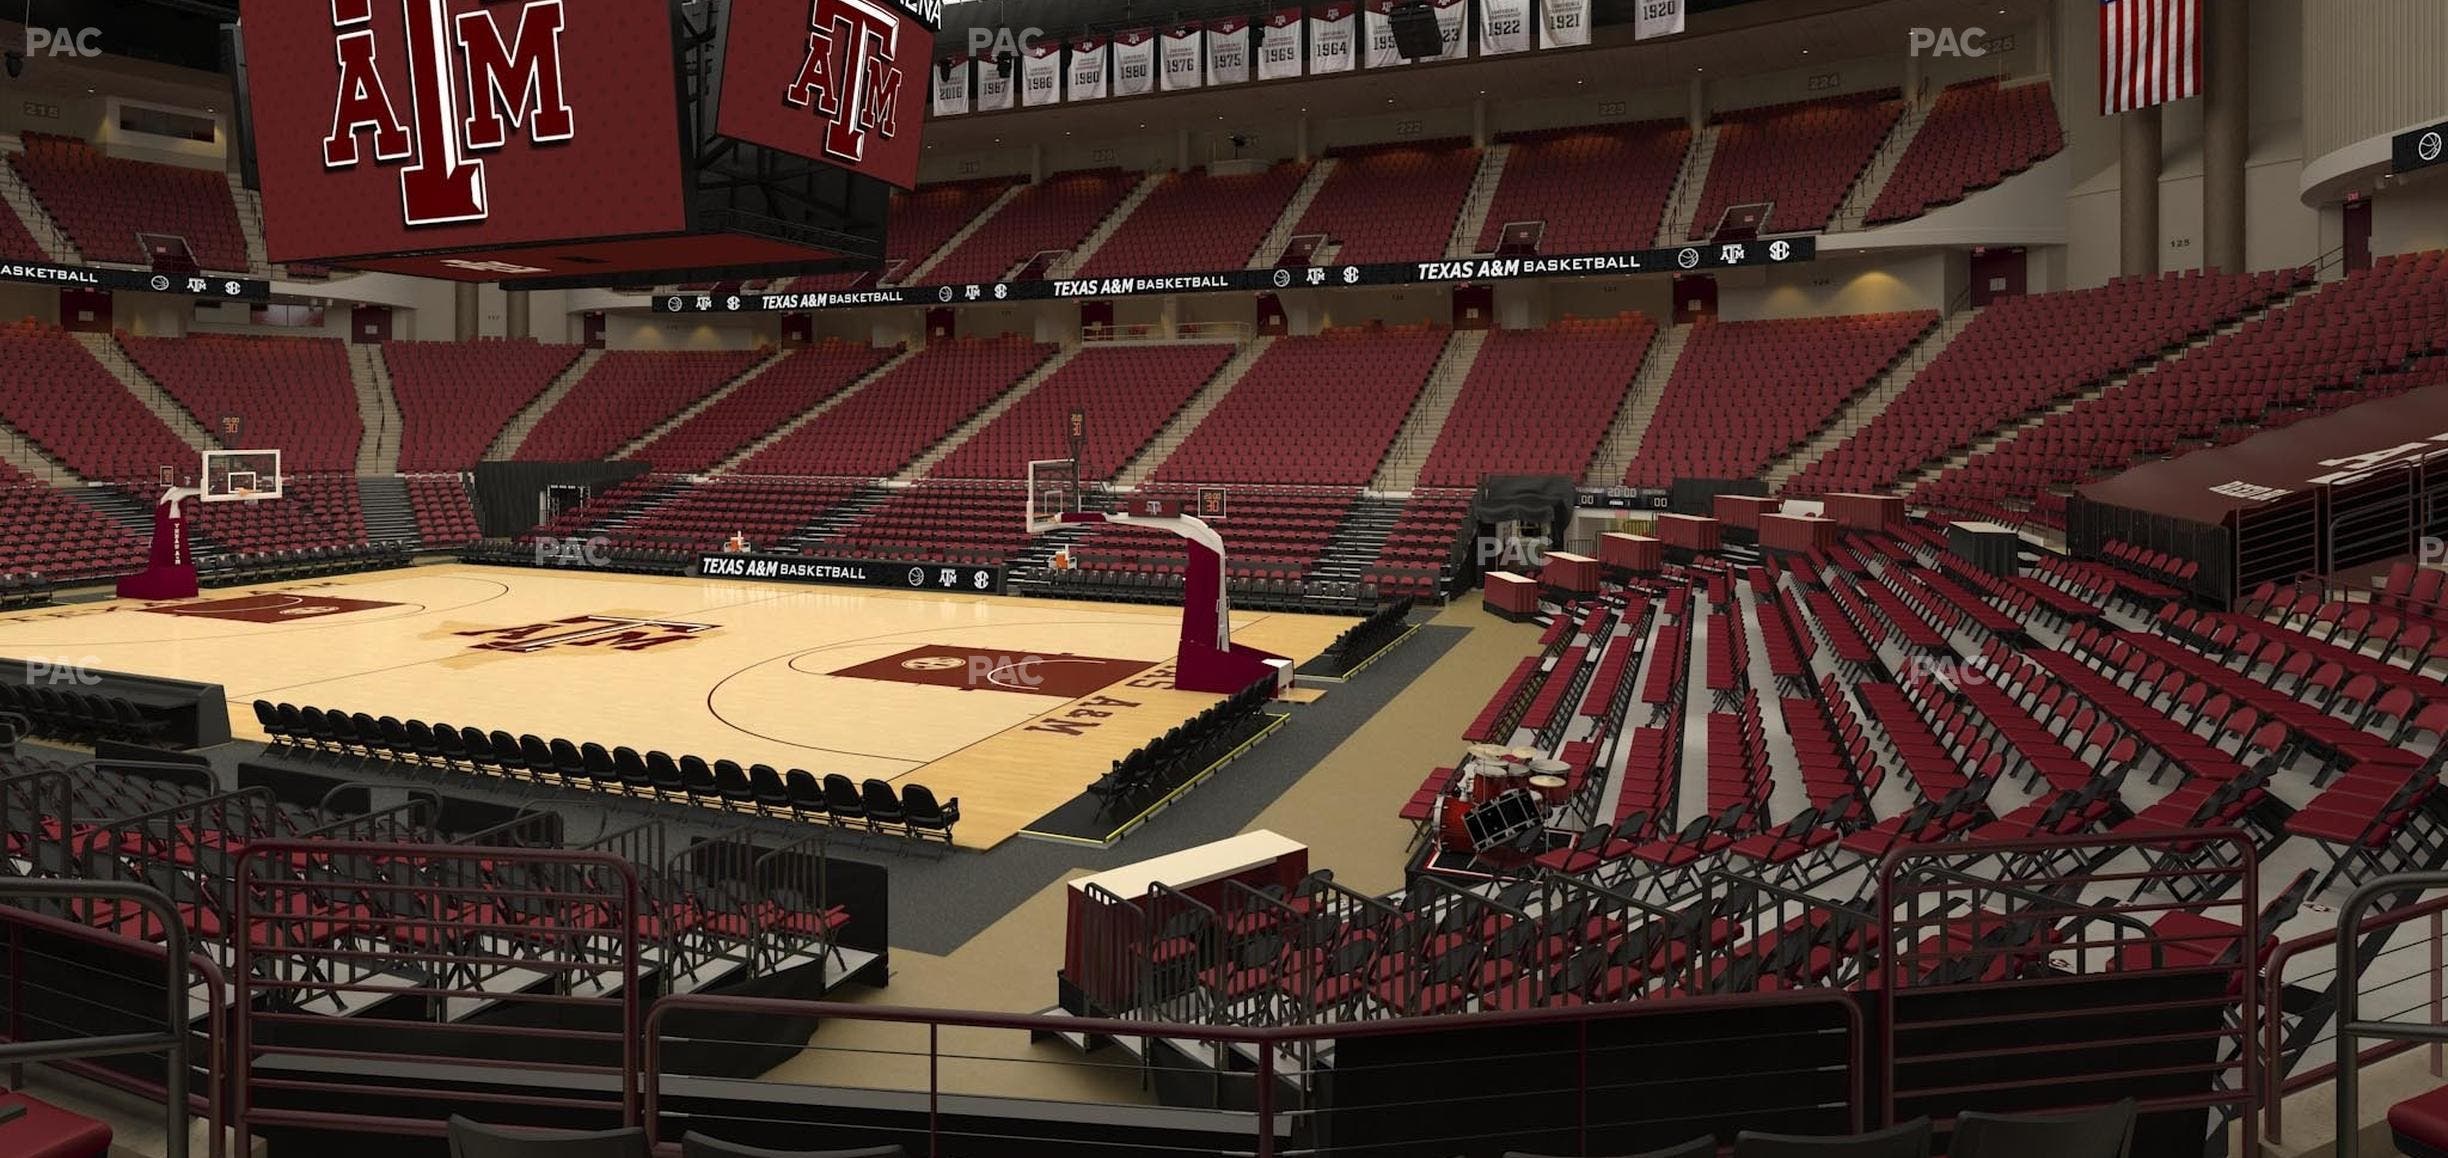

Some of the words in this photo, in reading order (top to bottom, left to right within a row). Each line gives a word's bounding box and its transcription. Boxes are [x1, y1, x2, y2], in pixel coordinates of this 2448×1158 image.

[1643, 1, 1675, 21] 1920
[1488, 20, 1520, 37] 1922
[1550, 13, 1580, 30] 1921
[1316, 41, 1347, 58] 1964
[1373, 36, 1396, 51] 195
[1214, 53, 1242, 70] 1975
[1265, 47, 1294, 64] 1969
[1120, 64, 1147, 80] 1980
[1166, 57, 1194, 74] 1976
[1027, 77, 1053, 92] 1986
[1074, 70, 1100, 86] 1980
[0, 263, 98, 283] ASKETBALL
[1418, 262, 1473, 280] TEXAS
[1477, 259, 1520, 278] A&M
[1523, 256, 1641, 273] BASKETBALL
[1053, 280, 1098, 296] TEXAS
[1100, 278, 1134, 294] A&M
[1136, 275, 1229, 291] BASKETBALL
[762, 295, 798, 309] TEXAS
[800, 293, 827, 308] A&M
[829, 291, 903, 304] BASKETBALL
[1581, 495, 1594, 505] 00
[1608, 486, 1637, 499] 20:00
[1206, 500, 1219, 512] 30
[1653, 497, 1668, 507] 00
[703, 558, 744, 575] TEXAS
[746, 560, 777, 577] A&M
[780, 563, 866, 580] BASKETBALL
